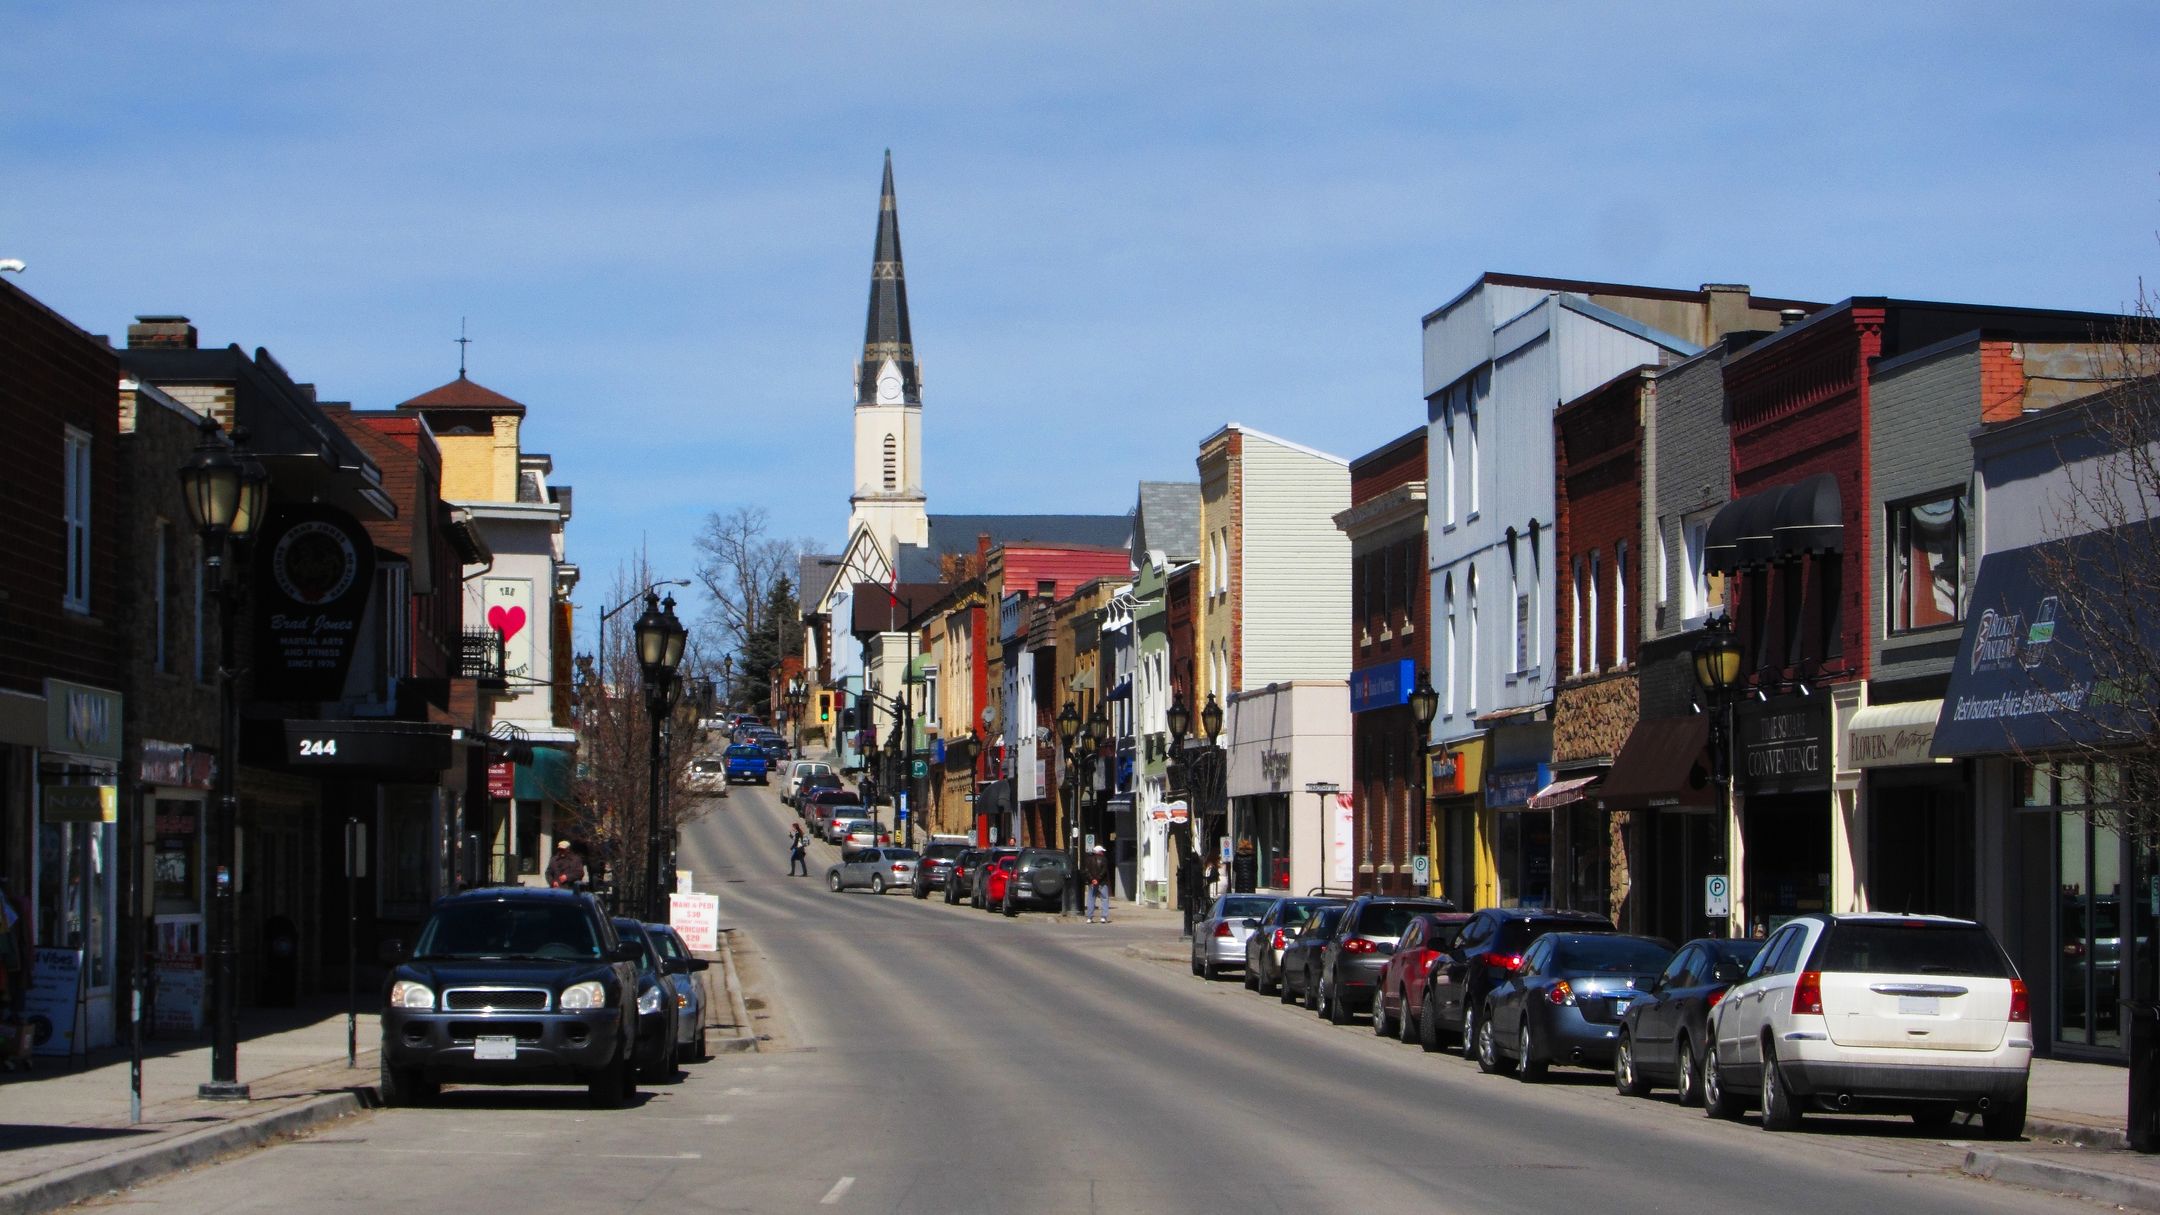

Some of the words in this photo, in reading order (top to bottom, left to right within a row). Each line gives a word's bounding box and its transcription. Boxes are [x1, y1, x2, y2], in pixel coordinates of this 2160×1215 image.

[499, 587, 515, 597] THE
[270, 613, 309, 629] Brad
[312, 614, 353, 635] Jones
[279, 637, 317, 646] MARTIAL
[321, 637, 344, 646] ARTS
[284, 648, 304, 657] AND
[307, 648, 341, 657] FITNESS
[287, 659, 313, 669] SINCE
[299, 739, 337, 756] 244
[1849, 732, 1887, 761] FLOWERS
[1748, 745, 1819, 777] CONVENIENCE
